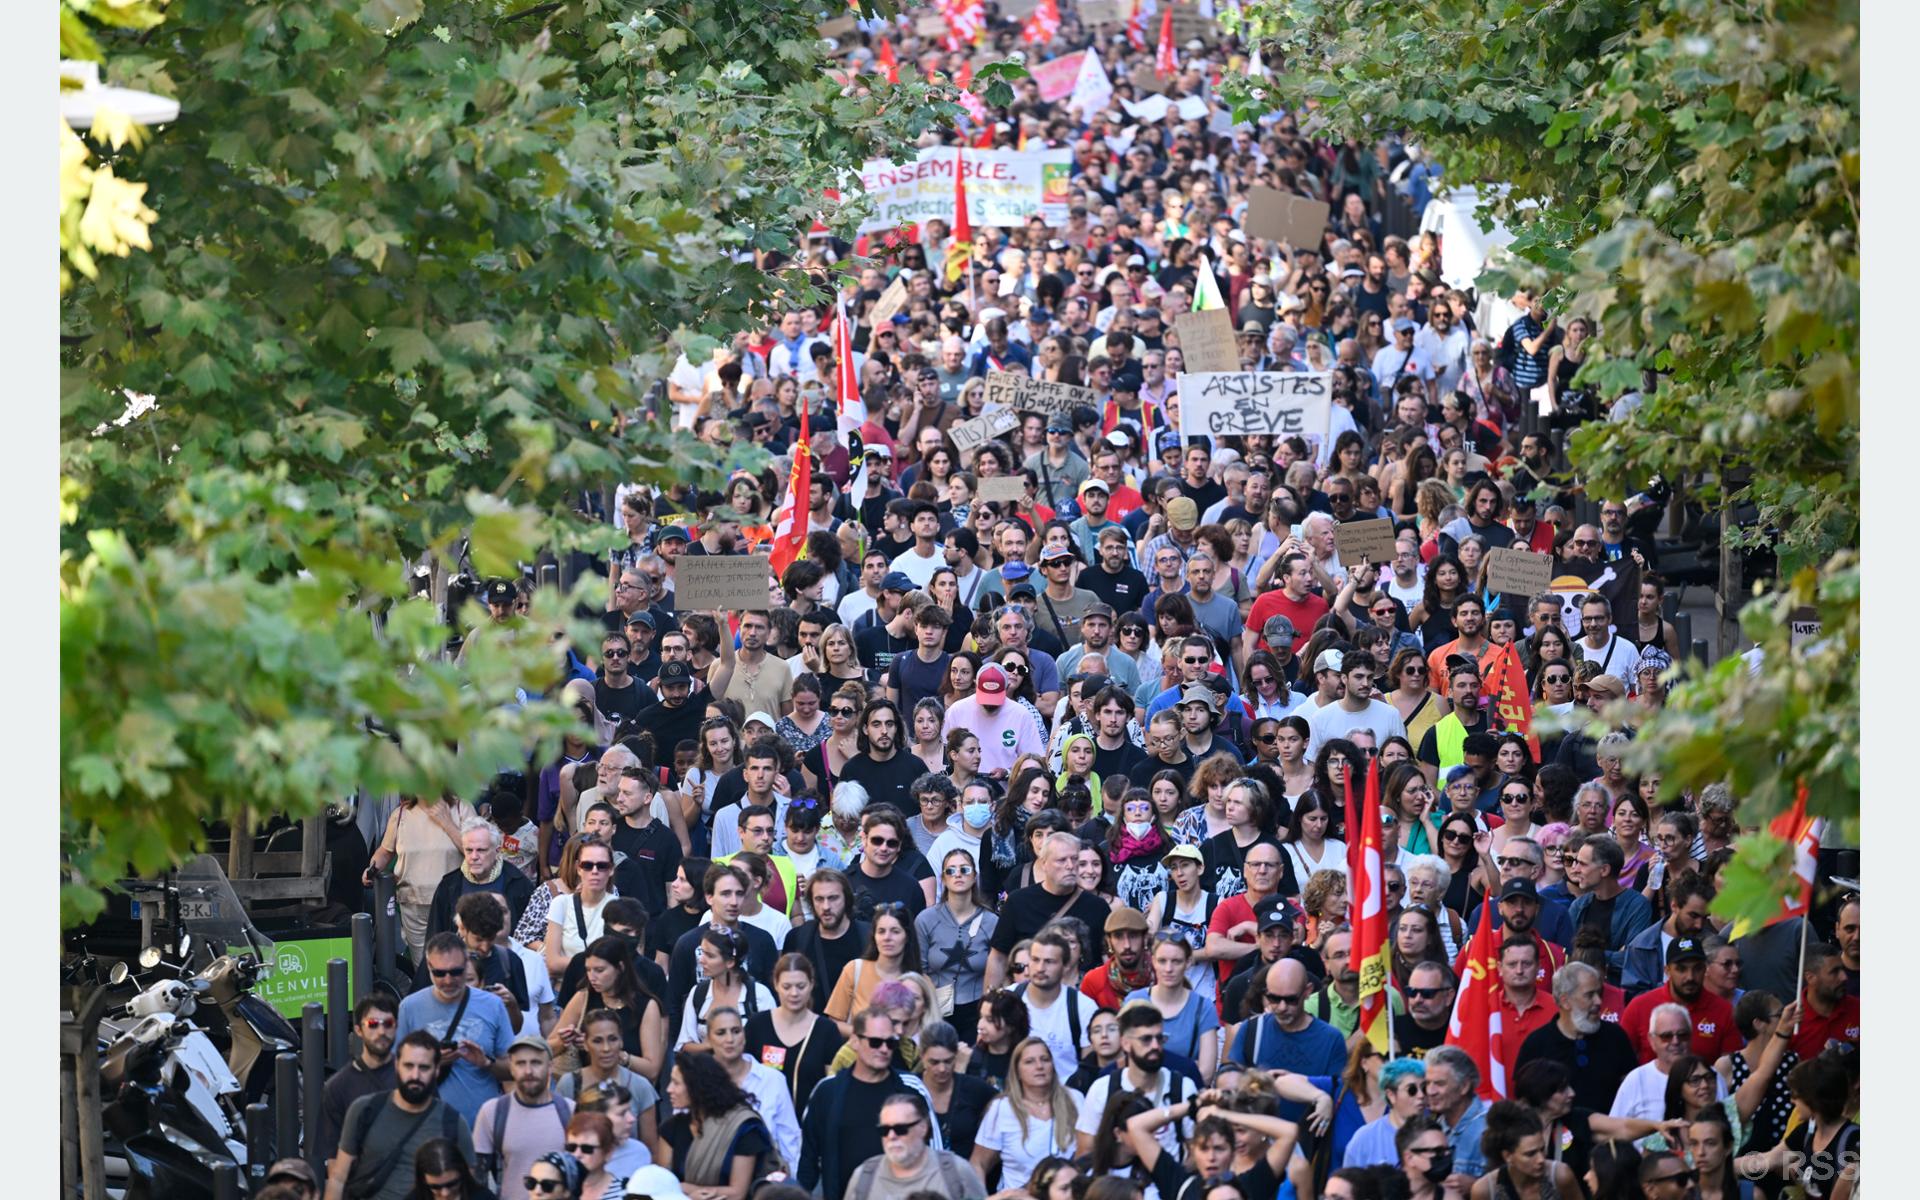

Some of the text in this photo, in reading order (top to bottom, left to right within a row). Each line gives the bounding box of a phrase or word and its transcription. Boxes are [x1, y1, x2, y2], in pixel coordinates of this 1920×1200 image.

[863, 159, 1017, 190] ENSEMBLE.
[887, 200, 957, 219] Protectio
[1025, 379, 1063, 396] GAFFE
[1069, 388, 1085, 400] ON
[1202, 372, 1325, 396] ARTISTES
[1234, 397, 1269, 411] EN
[1002, 730, 1016, 747] S
[1697, 1022, 1716, 1034] cgt
